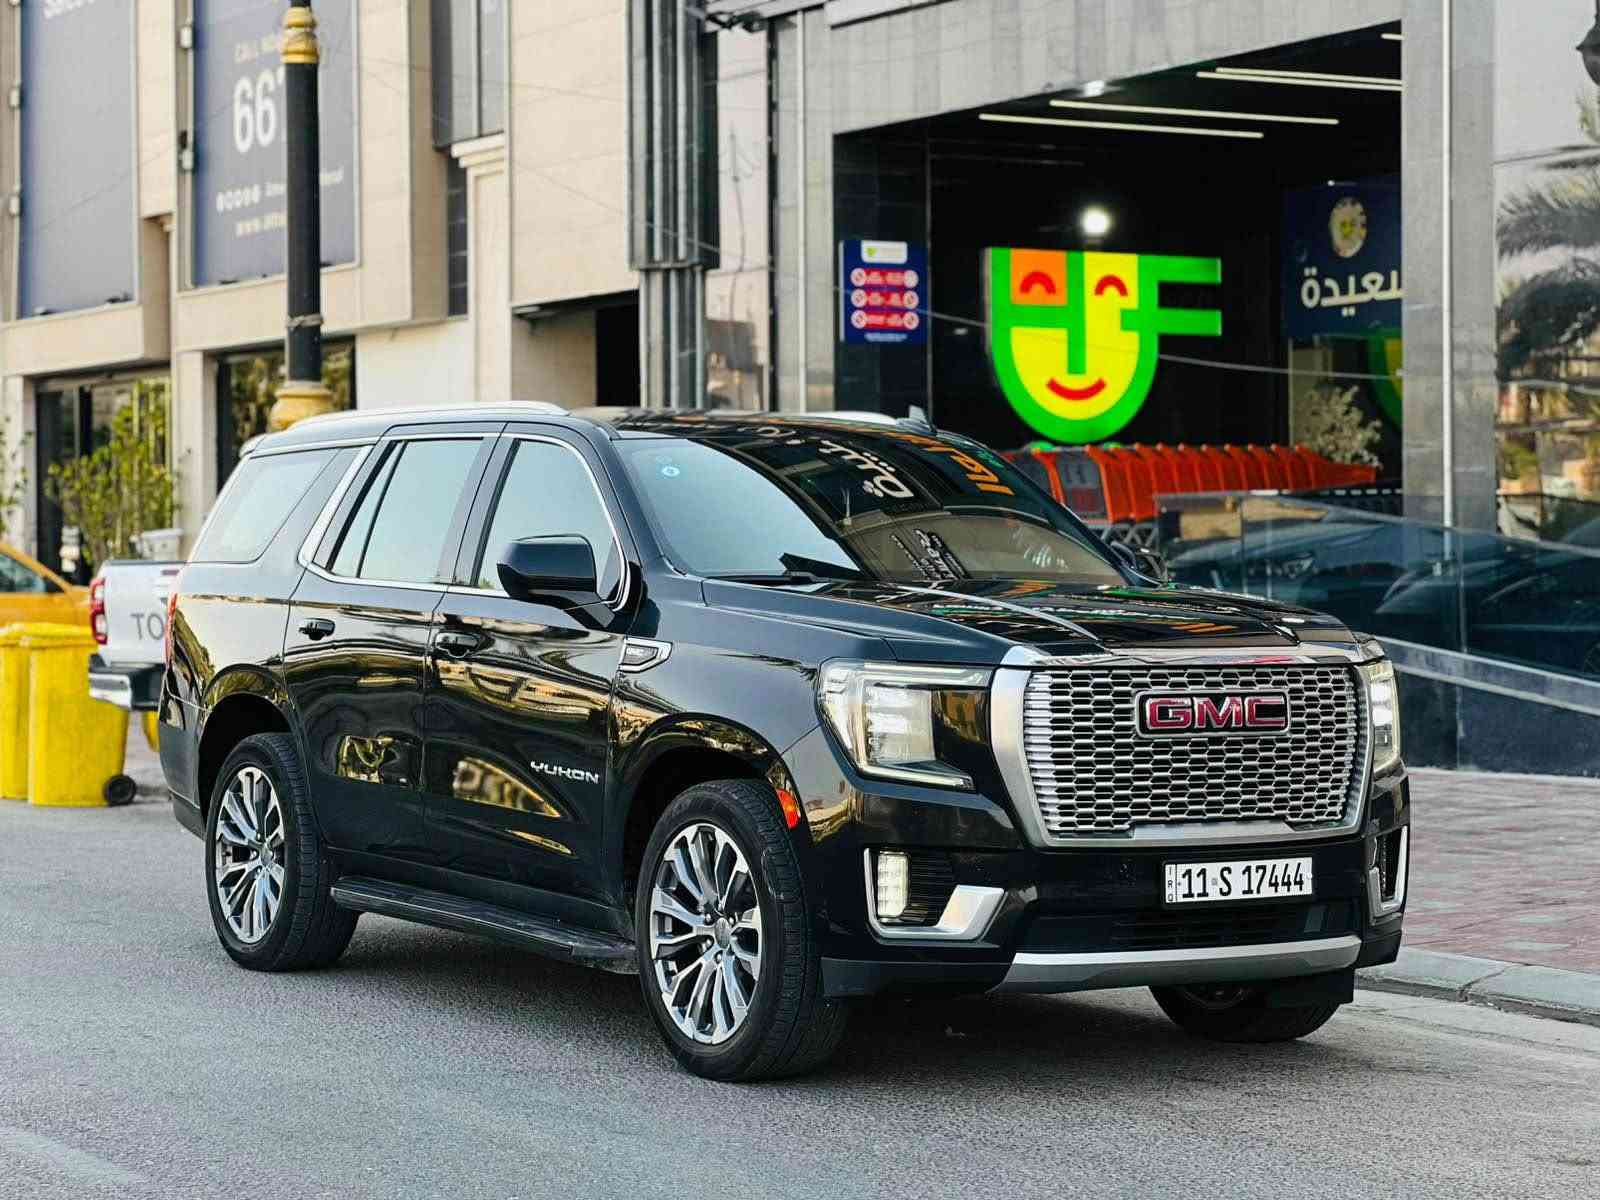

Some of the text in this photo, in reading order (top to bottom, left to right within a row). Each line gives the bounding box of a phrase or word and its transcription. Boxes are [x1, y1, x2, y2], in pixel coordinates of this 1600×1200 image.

[1146, 695, 1286, 730] GMC
[530, 760, 600, 785] YUKON
[1182, 862, 1304, 899] 11 S 17444
